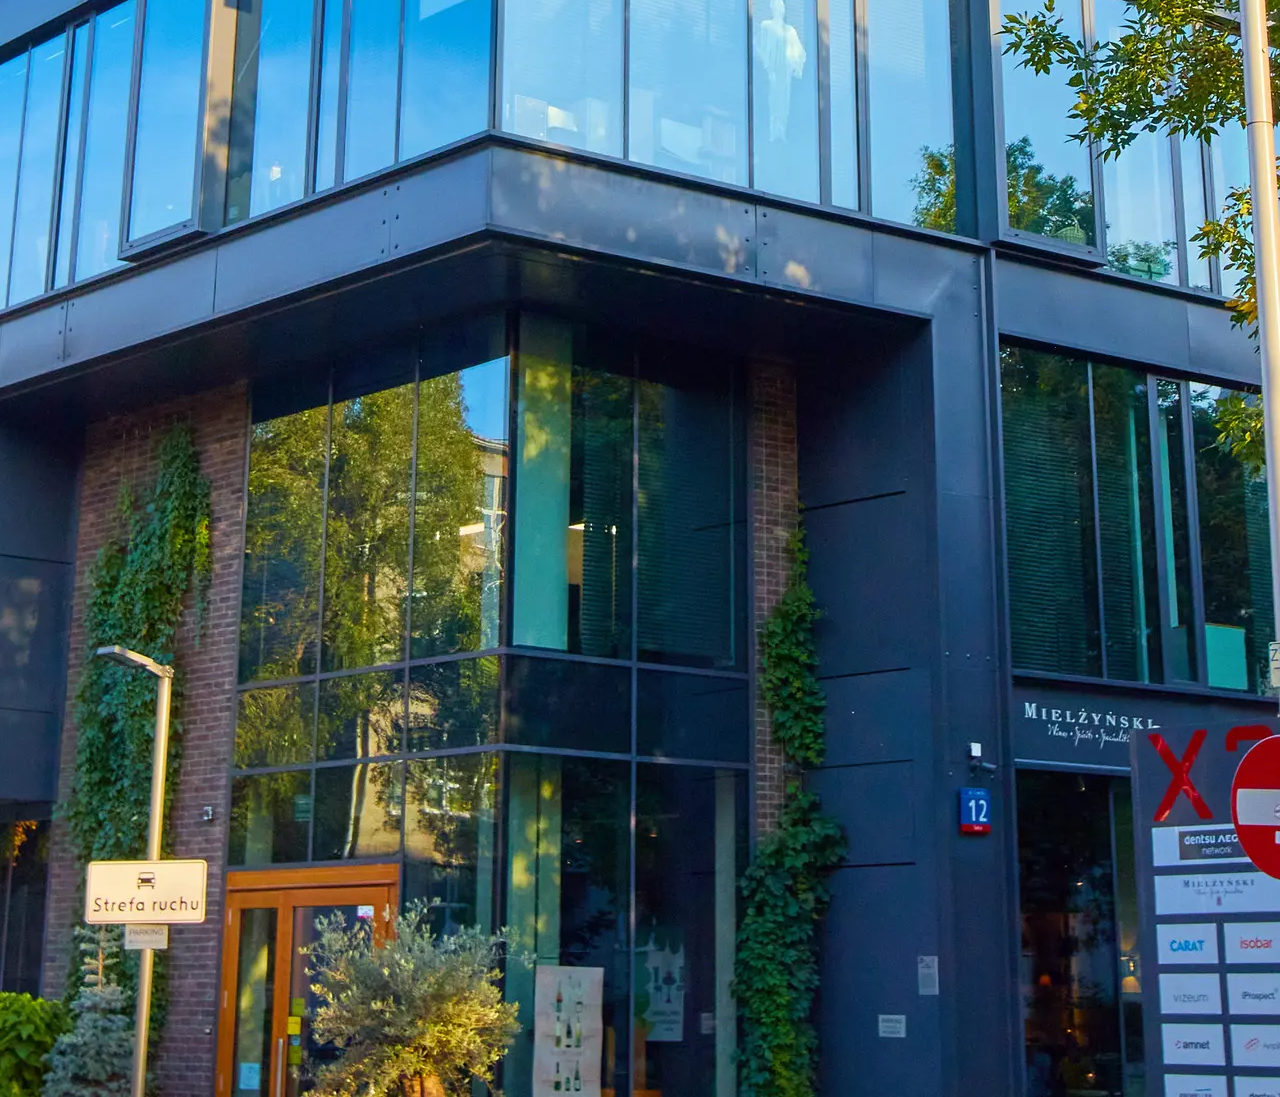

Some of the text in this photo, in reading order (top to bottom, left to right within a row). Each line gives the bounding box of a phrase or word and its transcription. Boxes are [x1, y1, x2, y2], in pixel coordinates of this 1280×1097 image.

[969, 800, 987, 821] 12
[1184, 834, 1239, 845] dentsu AEG
[1202, 846, 1233, 855] network
[93, 896, 199, 912] Strefa ruchu
[129, 928, 164, 936] PARKING
[1170, 940, 1205, 951] CARAT
[1240, 937, 1272, 949] isobar
[1173, 993, 1208, 1002] vizeum
[1183, 1040, 1210, 1049] amnet
